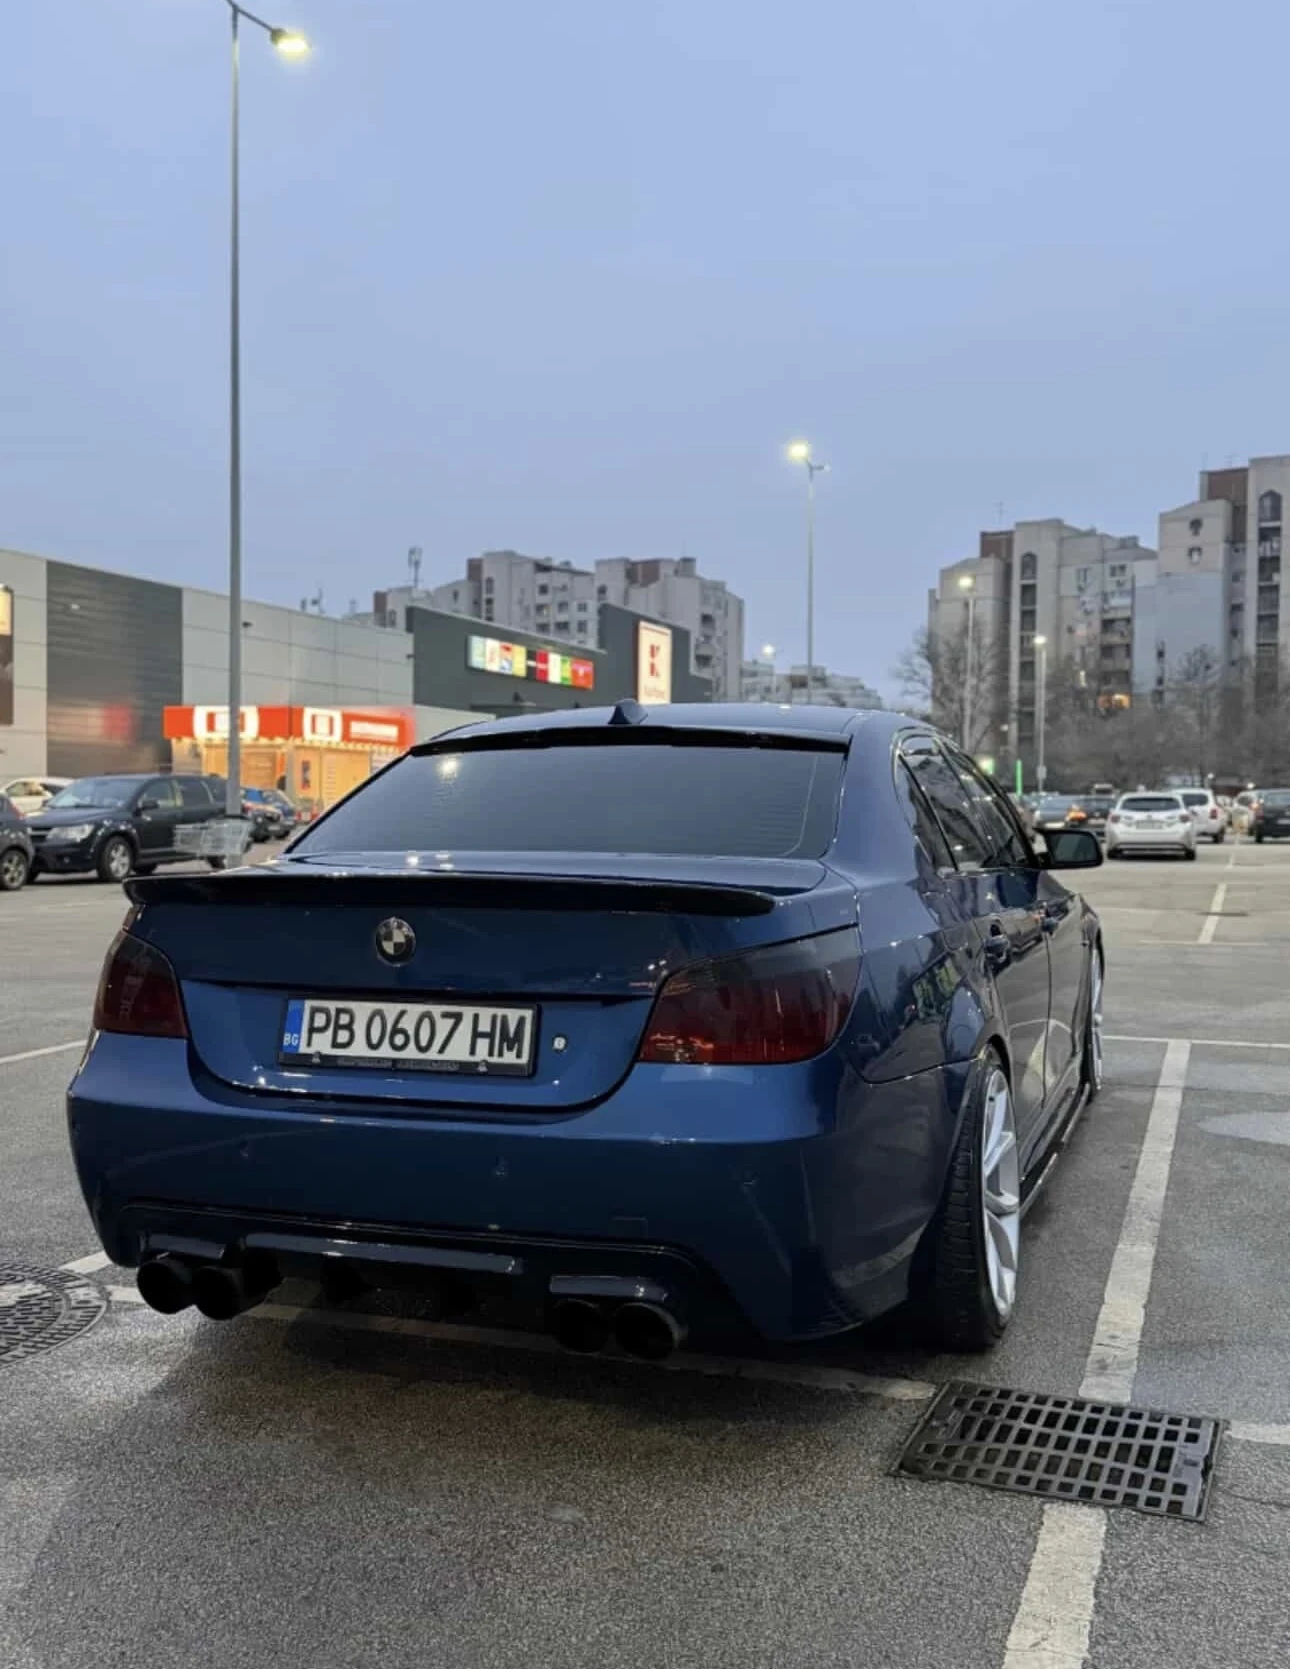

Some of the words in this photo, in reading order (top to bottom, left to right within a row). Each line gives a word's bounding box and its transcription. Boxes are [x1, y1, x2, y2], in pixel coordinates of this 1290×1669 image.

[283, 1032, 299, 1046] BG
[306, 1005, 356, 1050] PB
[364, 1008, 463, 1055] 0607
[469, 1012, 526, 1059] HM
